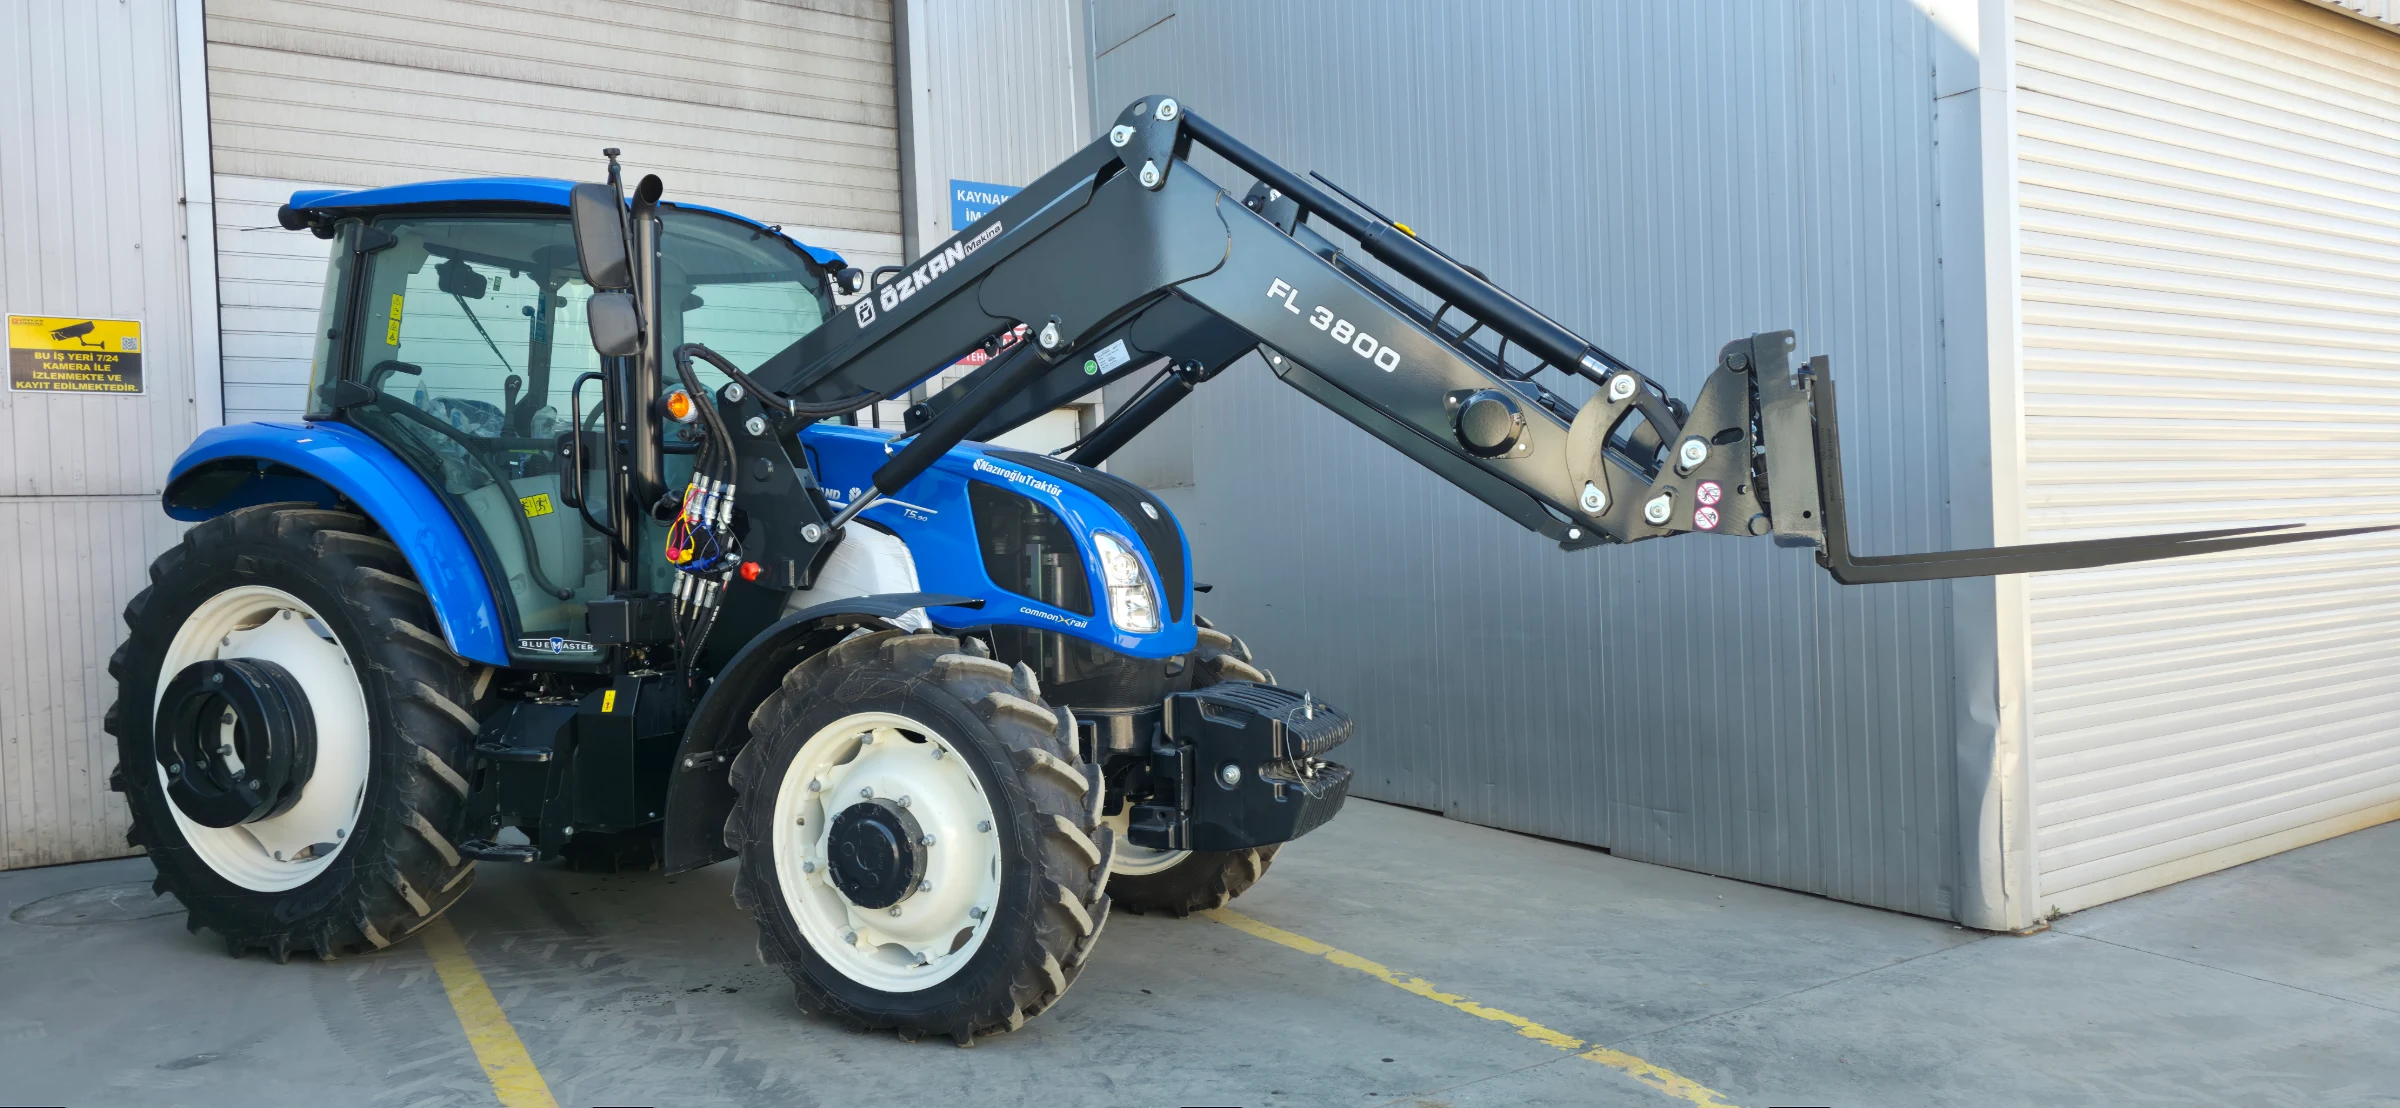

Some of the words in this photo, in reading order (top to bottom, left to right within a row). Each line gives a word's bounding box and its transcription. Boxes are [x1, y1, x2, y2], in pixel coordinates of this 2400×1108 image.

[957, 189, 1013, 206] KAYNAK
[965, 207, 987, 222] İM
[880, 240, 966, 312] ÖZKAN
[965, 225, 1001, 253] Makina
[1266, 277, 1301, 315] FL
[1309, 305, 1401, 373] 3800
[34, 351, 50, 360] BU
[53, 351, 64, 362] İŞ
[67, 353, 94, 361] YERİ
[96, 354, 119, 362] 7/24
[43, 362, 91, 371] KAMERA
[94, 363, 111, 372] İLE
[32, 371, 104, 381] İZLENMEKTE
[107, 374, 122, 382] VE
[16, 381, 51, 389] KAYIT
[53, 382, 139, 392] EDİLMEKTEDİR.
